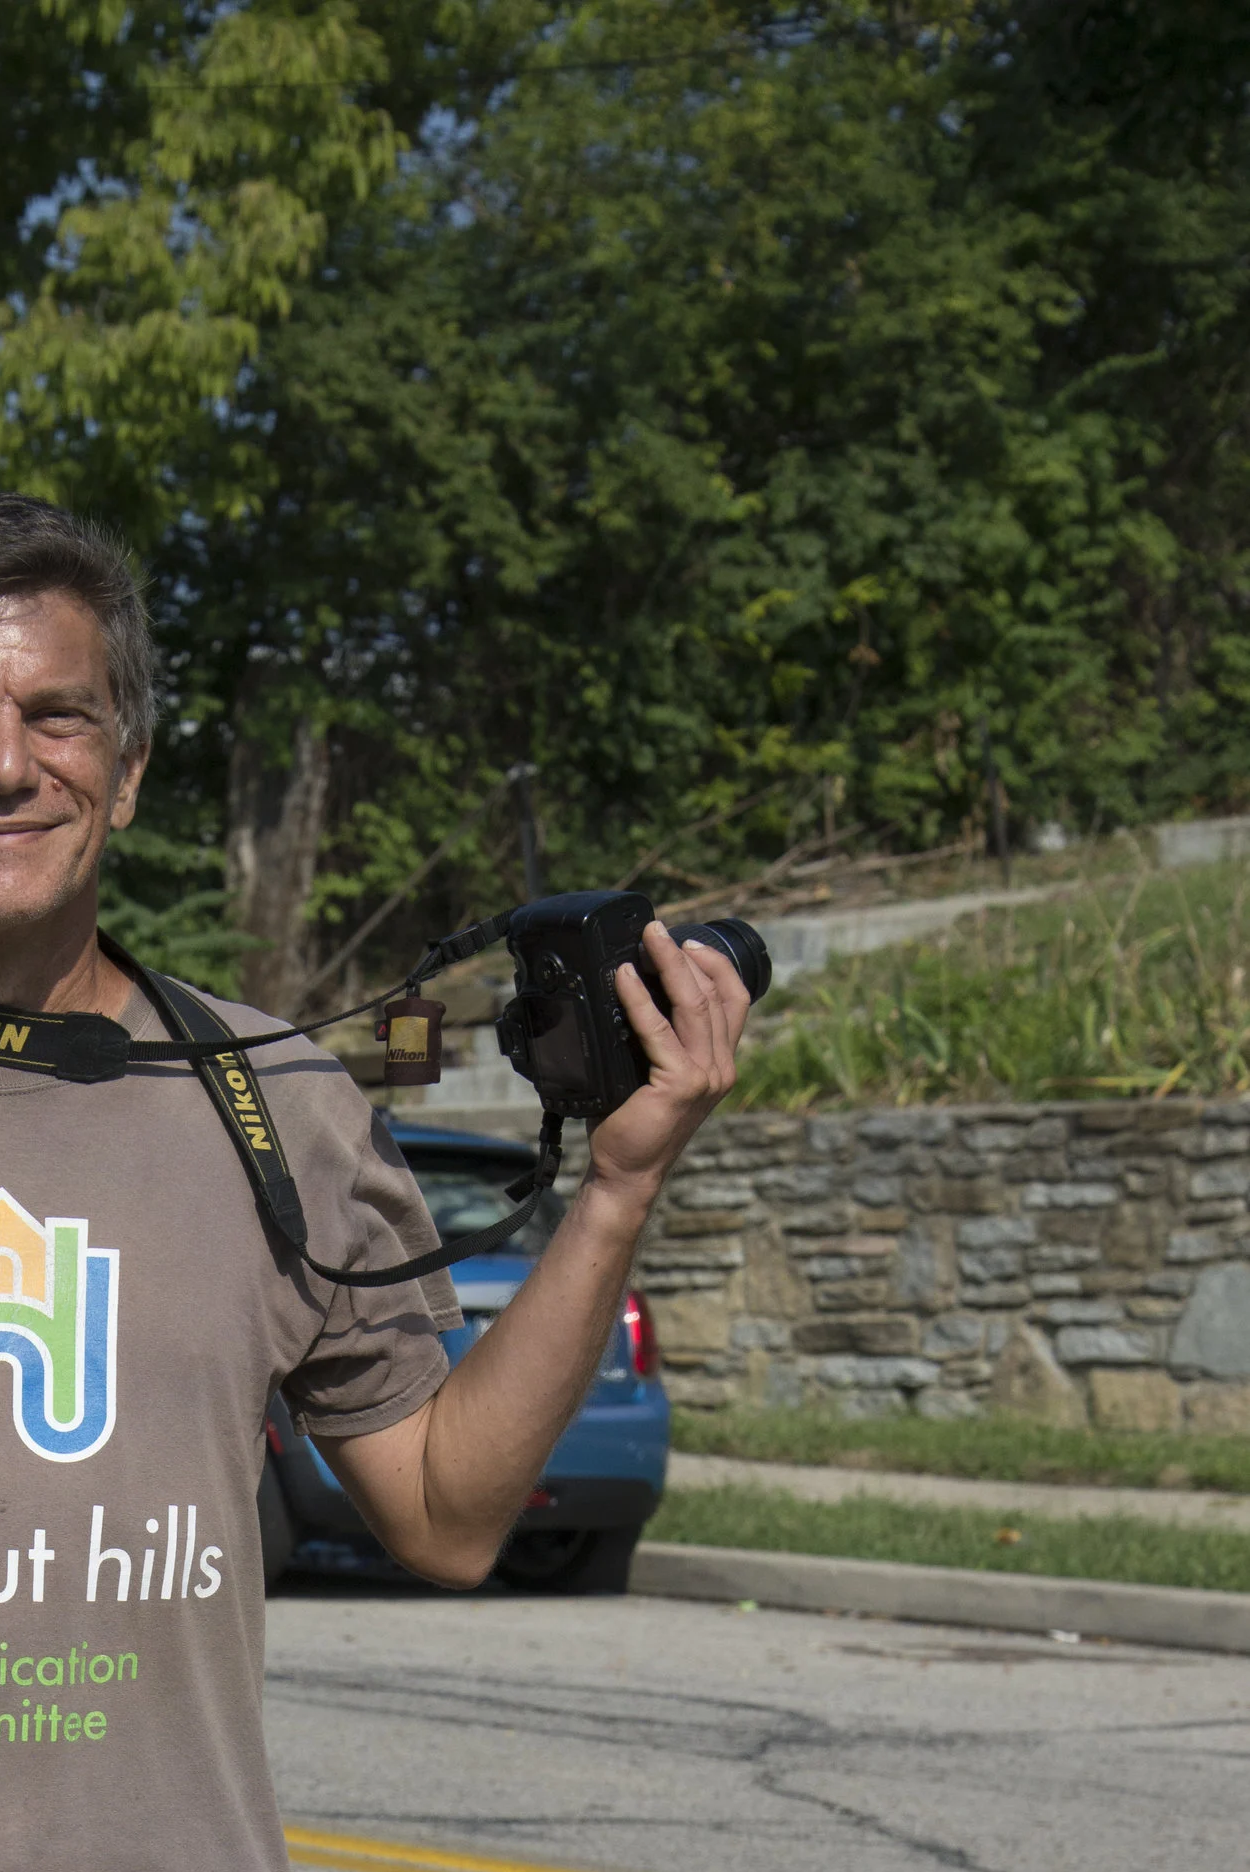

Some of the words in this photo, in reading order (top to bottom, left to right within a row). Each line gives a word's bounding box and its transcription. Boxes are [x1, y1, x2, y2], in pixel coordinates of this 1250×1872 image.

[215, 1052, 271, 1151] Nikon
[387, 1048, 426, 1061] Nikon
[86, 1505, 223, 1602] hills
